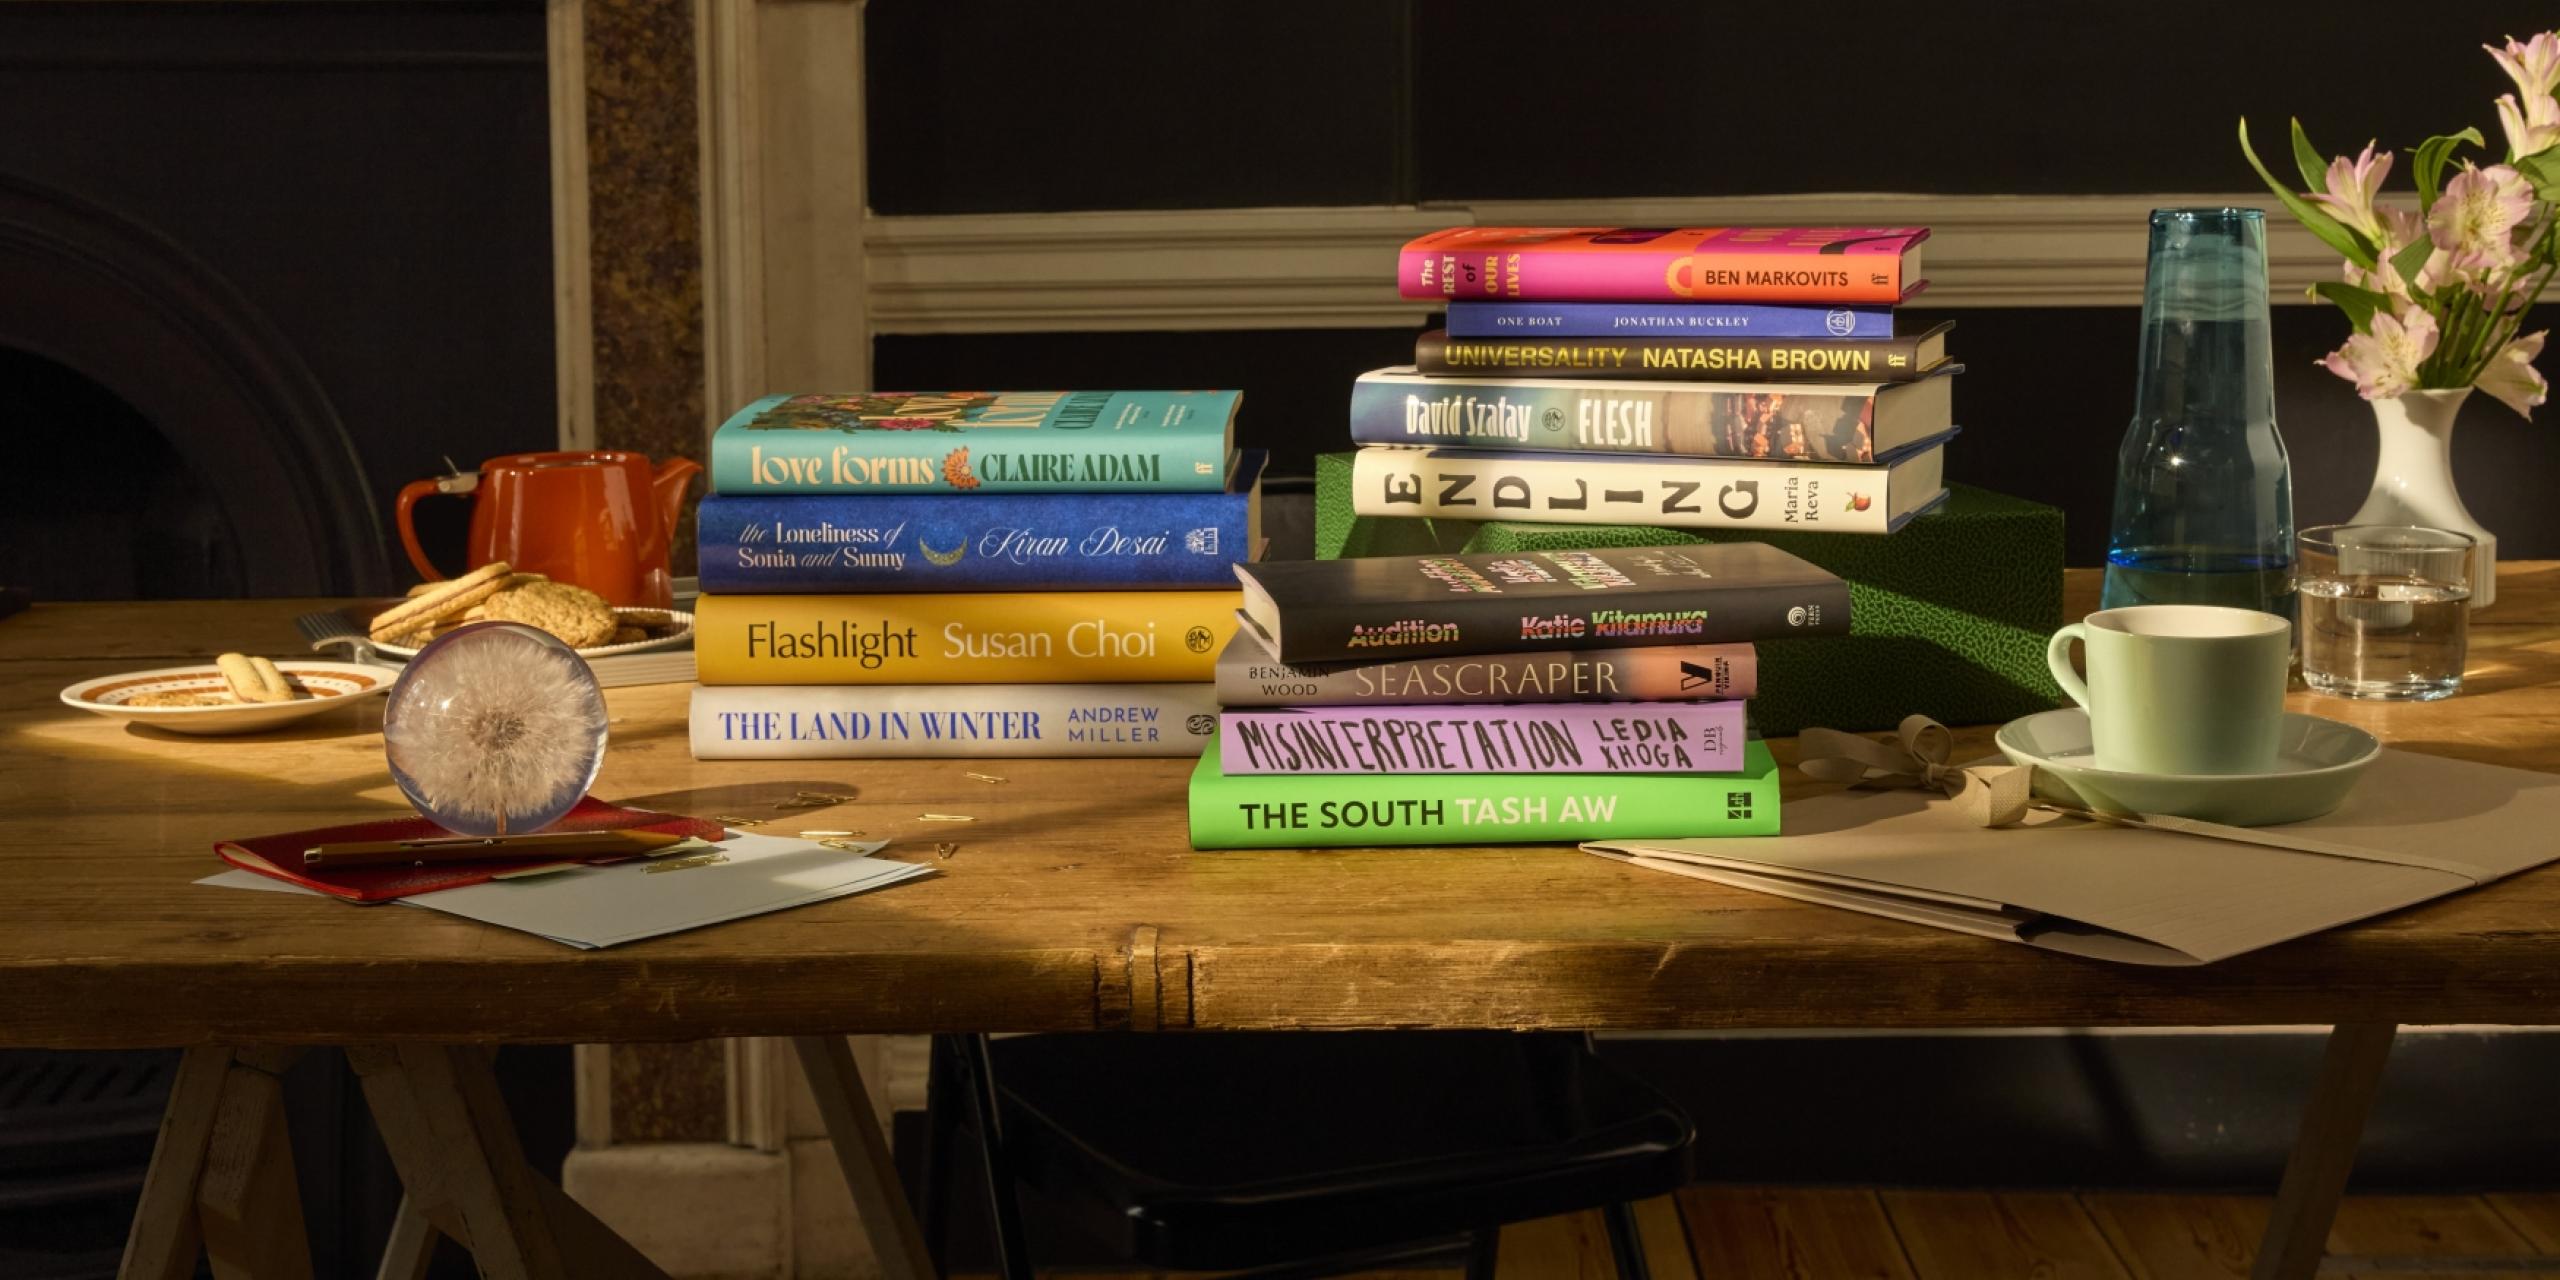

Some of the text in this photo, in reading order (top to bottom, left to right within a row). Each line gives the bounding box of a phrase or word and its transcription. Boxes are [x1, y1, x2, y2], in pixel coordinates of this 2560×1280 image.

[1421, 258, 1435, 287] The
[1441, 255, 1456, 295] REST
[1462, 262, 1476, 283] of
[1484, 255, 1499, 294] OUR
[1506, 253, 1521, 297] LIVES
[1705, 269, 1849, 287] BEN MARKOVITS
[1497, 316, 1563, 327] ONE BOAT
[1613, 316, 1750, 328] JONATHAN BUCKLEY
[1444, 345, 1628, 368] UNIVERSALITY
[1643, 347, 1870, 371] NATASHA BROWN
[1406, 394, 1532, 443] David Szalay
[1579, 398, 1653, 447] FLESH
[751, 445, 936, 485] love forms
[979, 453, 1161, 483] CLAIRE ADAM
[1384, 472, 1759, 520] ENDLING
[1784, 476, 1799, 523] Maria
[1805, 480, 1819, 522] Reva
[739, 520, 907, 550] the Loneliness of
[978, 525, 1170, 566] Kiran Desai
[738, 546, 906, 571] Sonia and Sunny
[943, 619, 1156, 659] Susan Choi
[1346, 619, 1460, 649] Audition
[1519, 609, 1709, 641] Katie Kitamura
[748, 620, 919, 670] Flashlight
[1248, 665, 1331, 682] BENJAMIN
[1355, 660, 1621, 697] SEASCRAPER
[1261, 683, 1319, 697] WOOD
[718, 711, 1044, 741] THE LAND IN WINTER
[1067, 707, 1160, 724] ANDREW
[1592, 717, 1689, 743] LEDIA
[1068, 727, 1160, 743] MILLER
[1235, 717, 1583, 773] MISINTERPRETATION
[1703, 727, 1717, 752] DB
[1598, 743, 1693, 770] XHOGA
[1239, 799, 1445, 830] THE SOUTH
[1454, 794, 1619, 826] TASH AW
